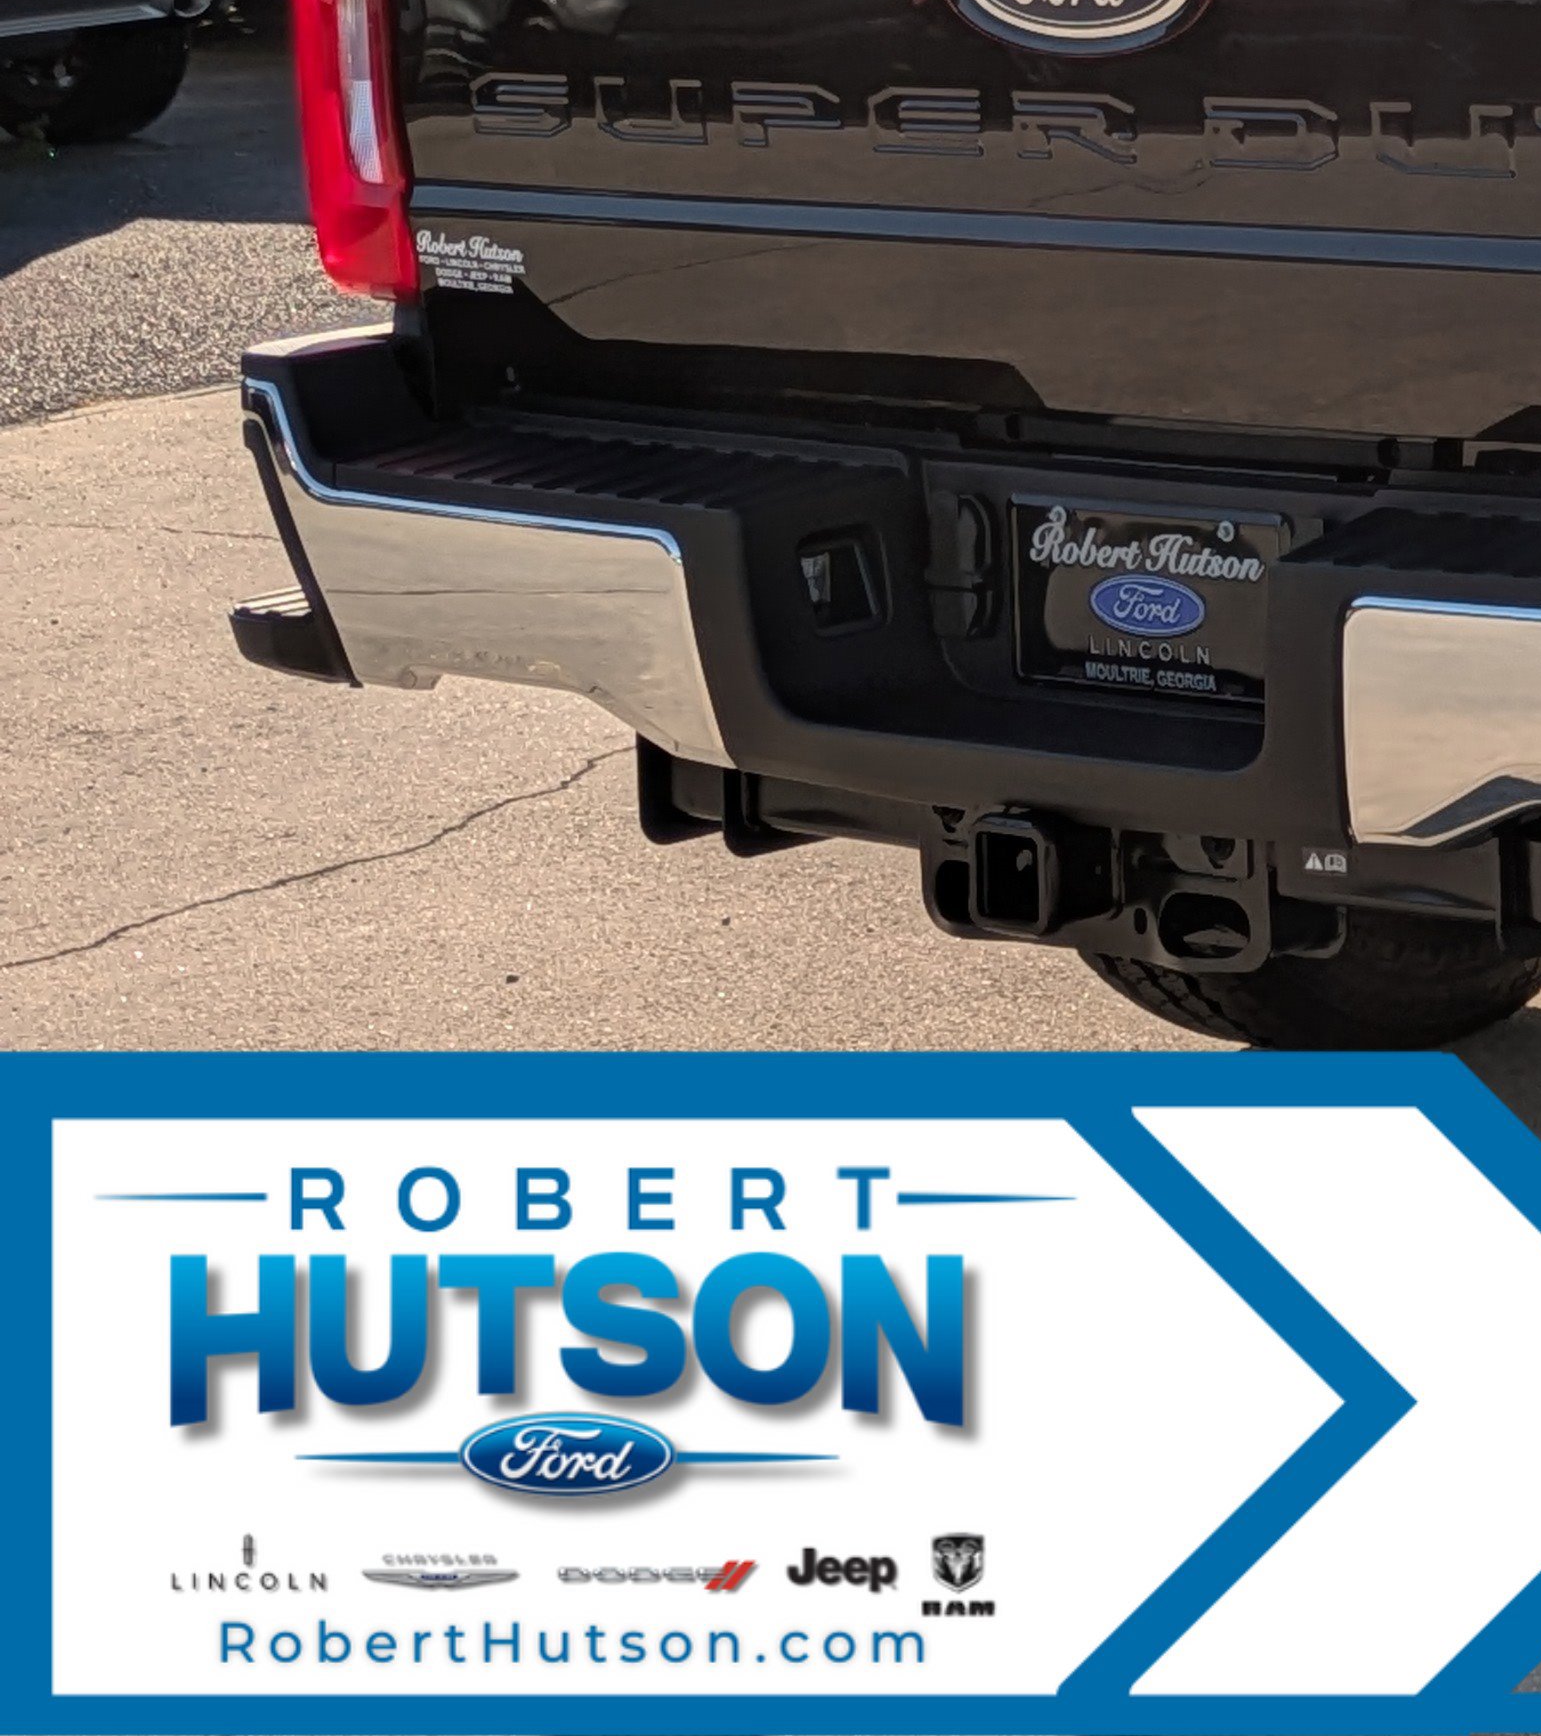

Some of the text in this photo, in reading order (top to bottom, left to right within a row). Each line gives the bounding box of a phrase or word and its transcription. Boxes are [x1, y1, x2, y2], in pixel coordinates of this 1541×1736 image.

[470, 73, 1137, 164] SUPER
[416, 229, 523, 262] Robert Hutson
[1030, 520, 1265, 582] Robert Hutson
[1113, 583, 1181, 624] Ford
[1089, 635, 1211, 665] LINCOLN
[1084, 661, 1217, 692] MOULTRIE, GEORGIA
